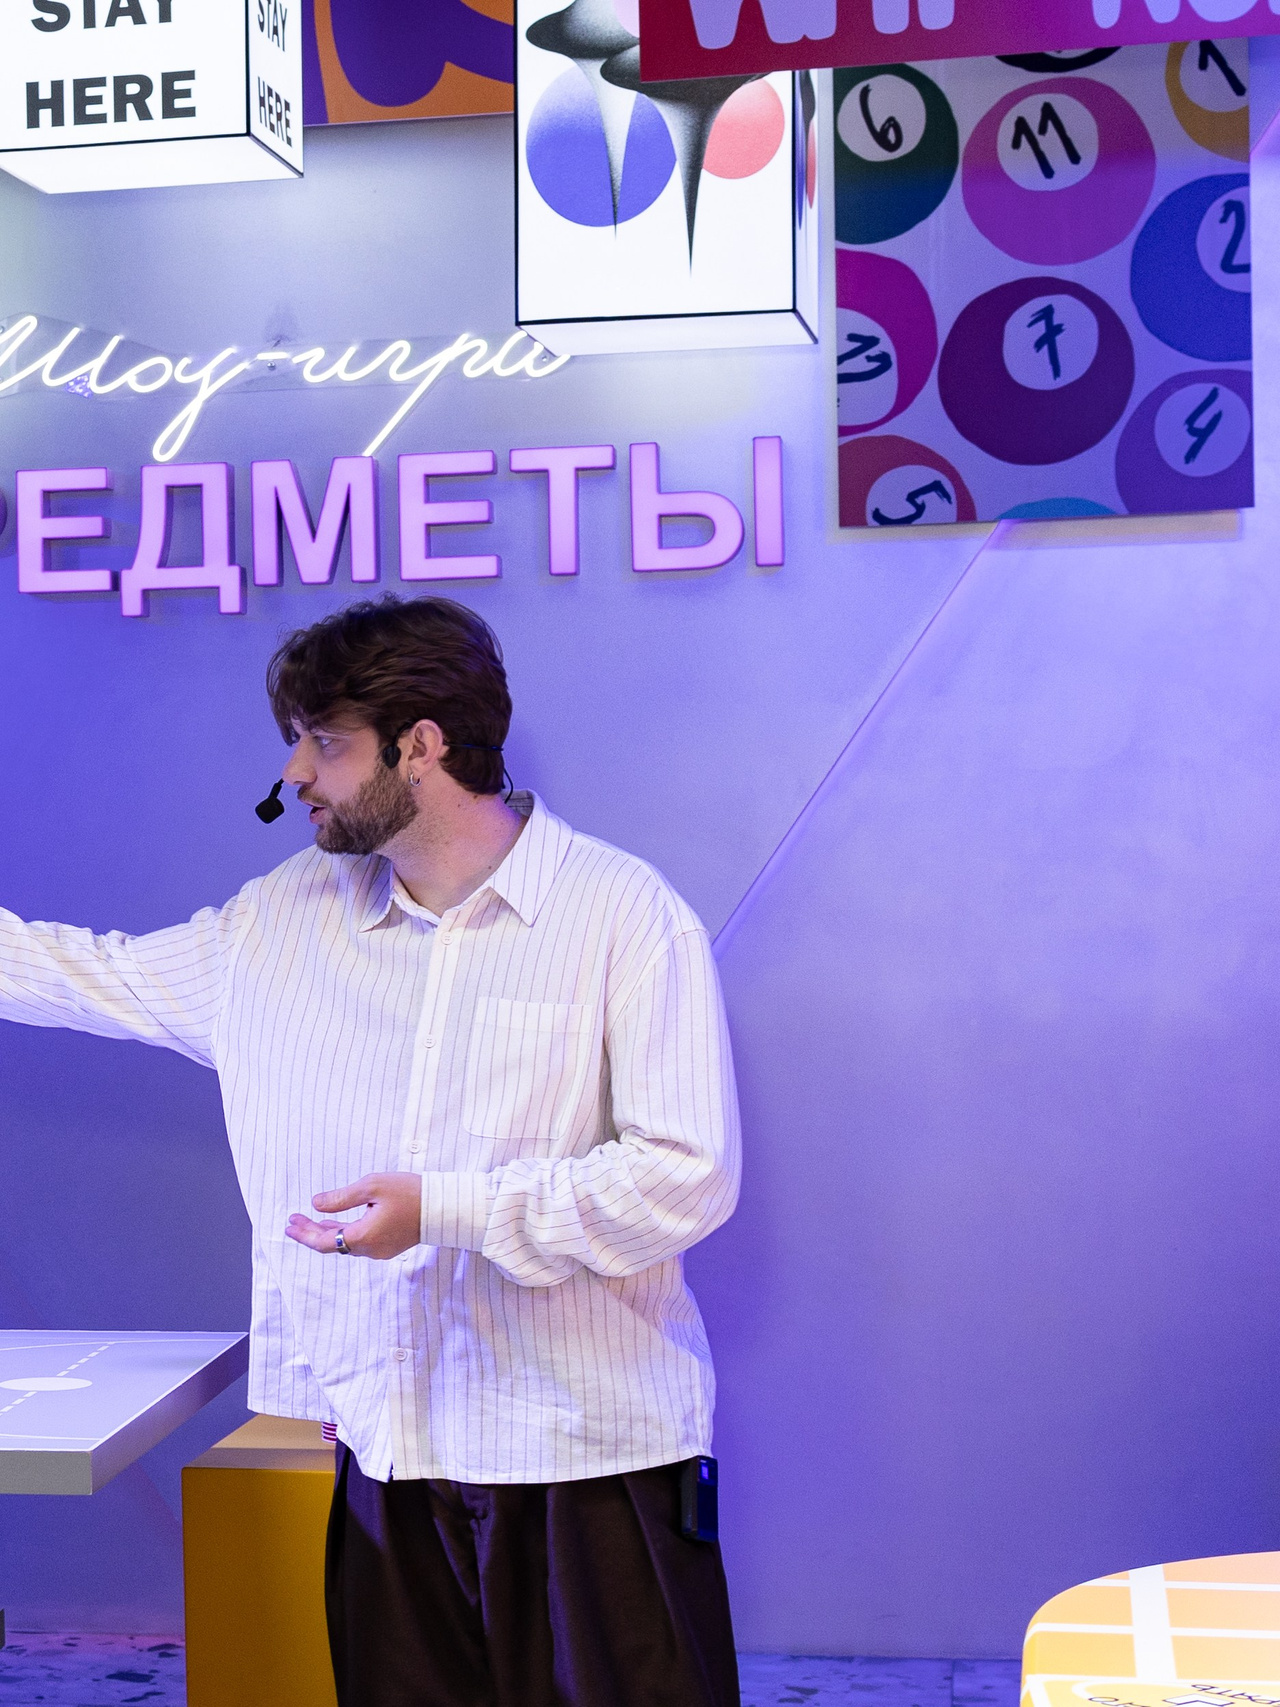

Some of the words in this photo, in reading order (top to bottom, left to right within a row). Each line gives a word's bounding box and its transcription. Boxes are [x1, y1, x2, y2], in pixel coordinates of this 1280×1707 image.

[26, 69, 196, 129] HERE
[257, 75, 292, 147] HERE
[859, 84, 903, 153] 6
[1012, 101, 1081, 180] 11
[1219, 200, 1250, 274] 2
[1027, 303, 1066, 380] 7
[1183, 387, 1223, 465] 4
